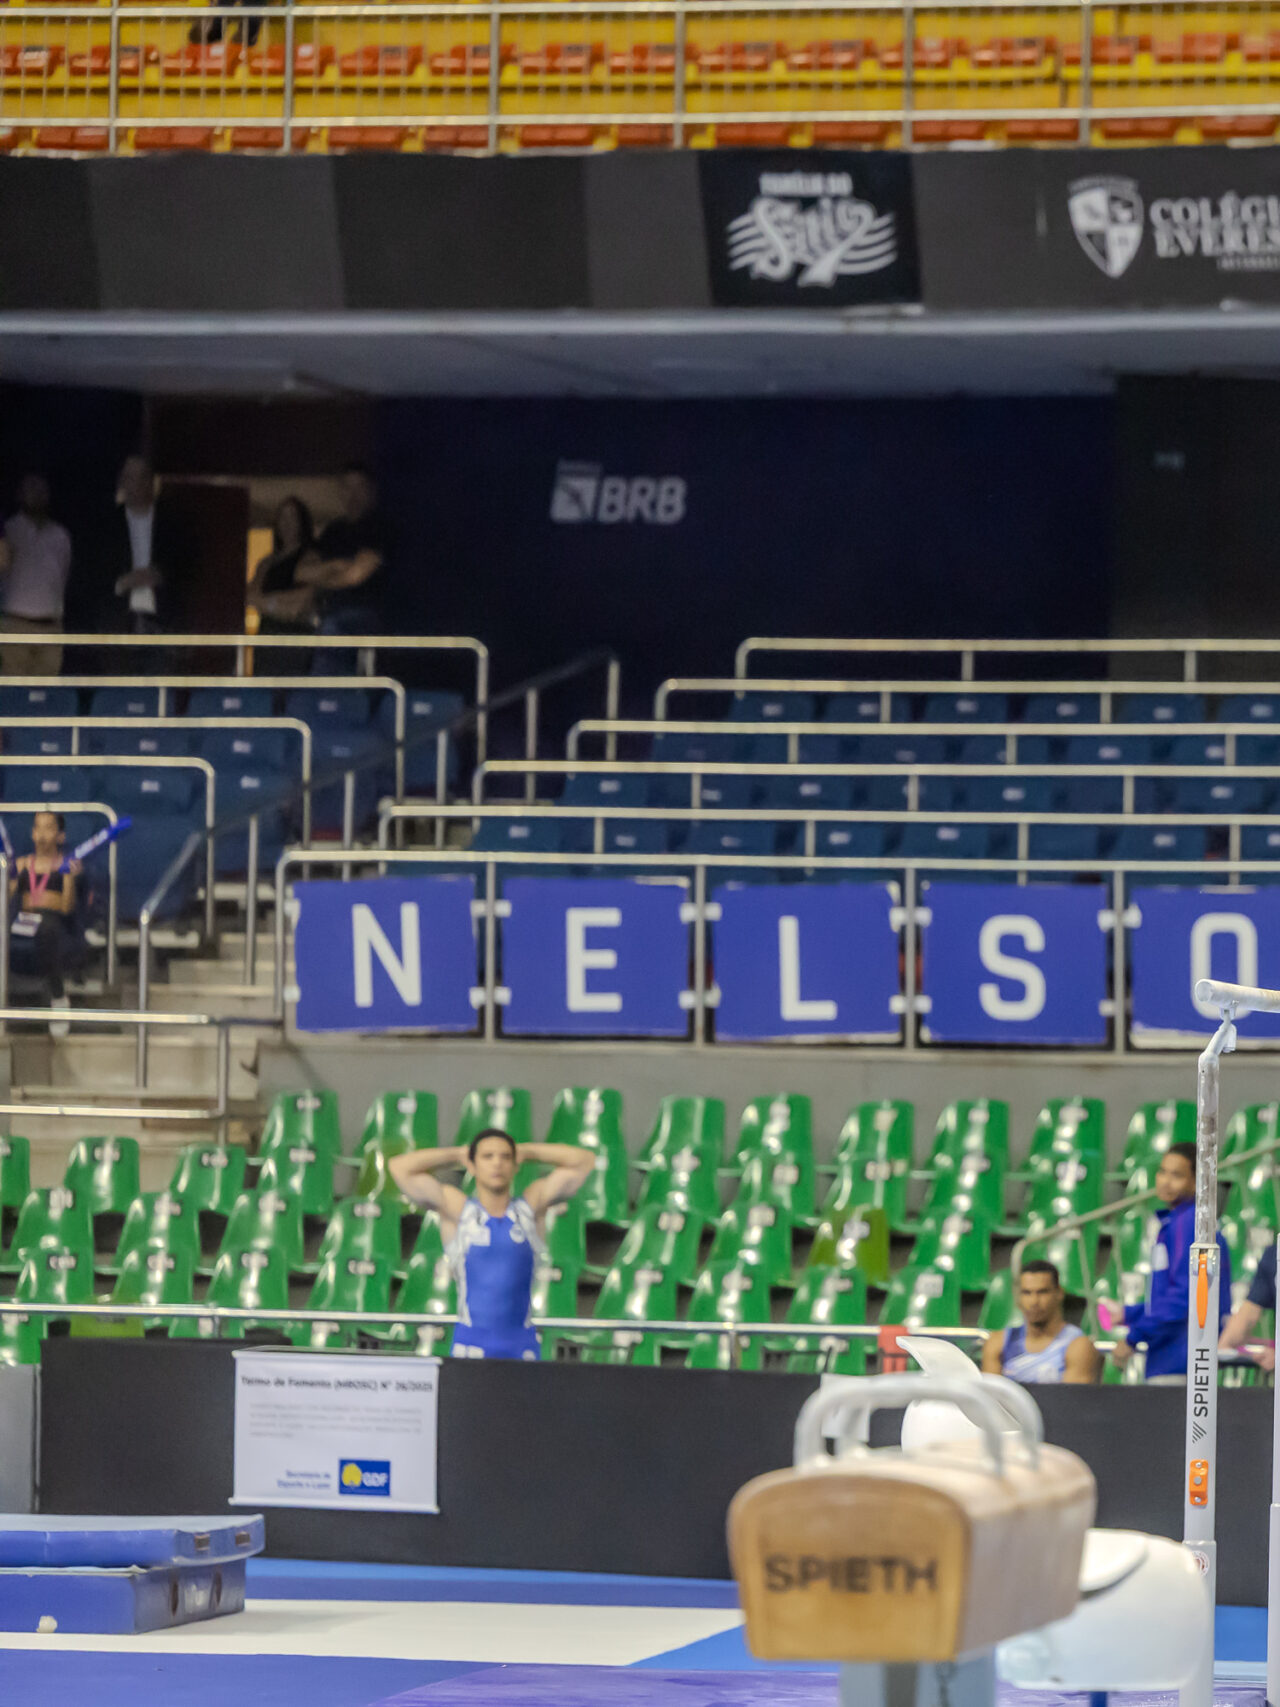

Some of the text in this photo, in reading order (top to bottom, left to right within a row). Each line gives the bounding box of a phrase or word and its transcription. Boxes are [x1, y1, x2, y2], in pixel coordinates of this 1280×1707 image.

[597, 475, 687, 524] BRB
[1193, 1347, 1210, 1418] SPIETH
[764, 1555, 939, 1594] SPIETH
